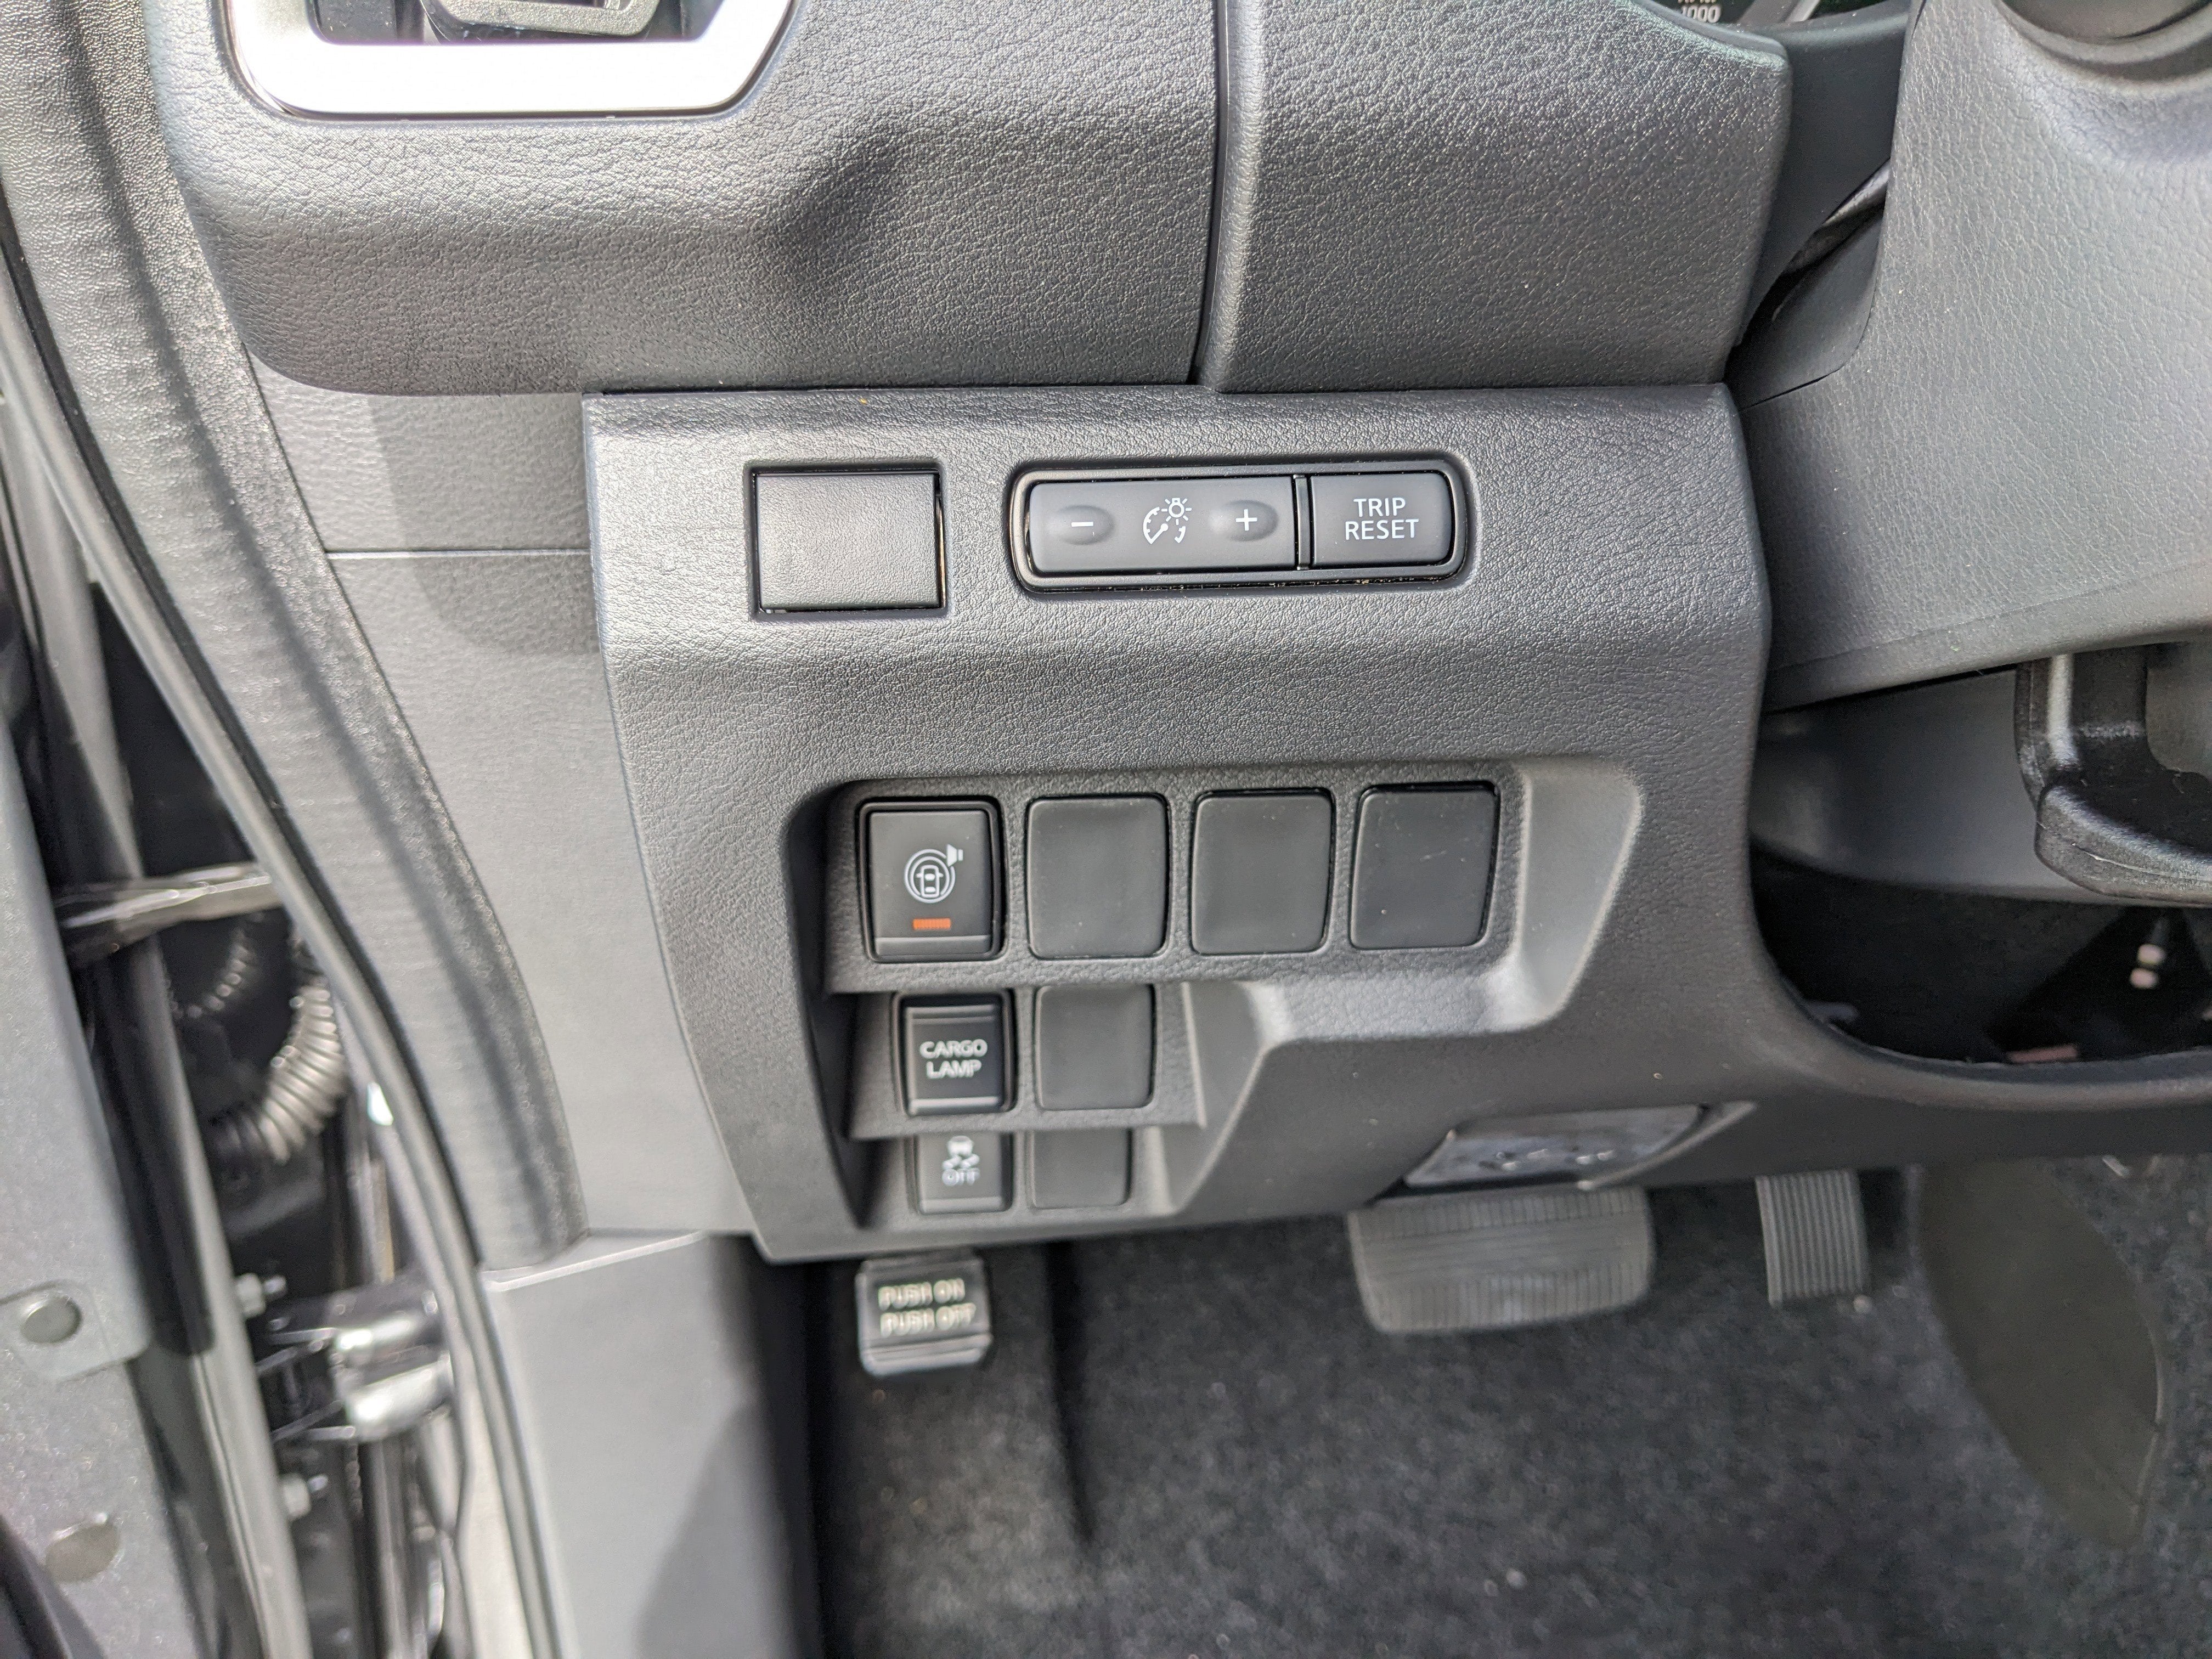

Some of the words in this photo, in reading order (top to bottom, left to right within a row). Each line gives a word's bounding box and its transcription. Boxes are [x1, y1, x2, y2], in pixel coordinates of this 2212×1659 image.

[1353, 498, 1406, 517] TRIP
[1345, 518, 1419, 540] RESET
[919, 1039, 988, 1059] CARGO
[926, 1059, 982, 1079] LAMP
[941, 1168, 980, 1186] OFF
[878, 1282, 933, 1311] PUSH
[933, 1278, 965, 1304] ON
[880, 1308, 935, 1338] PUSH
[935, 1302, 977, 1330] OFF
